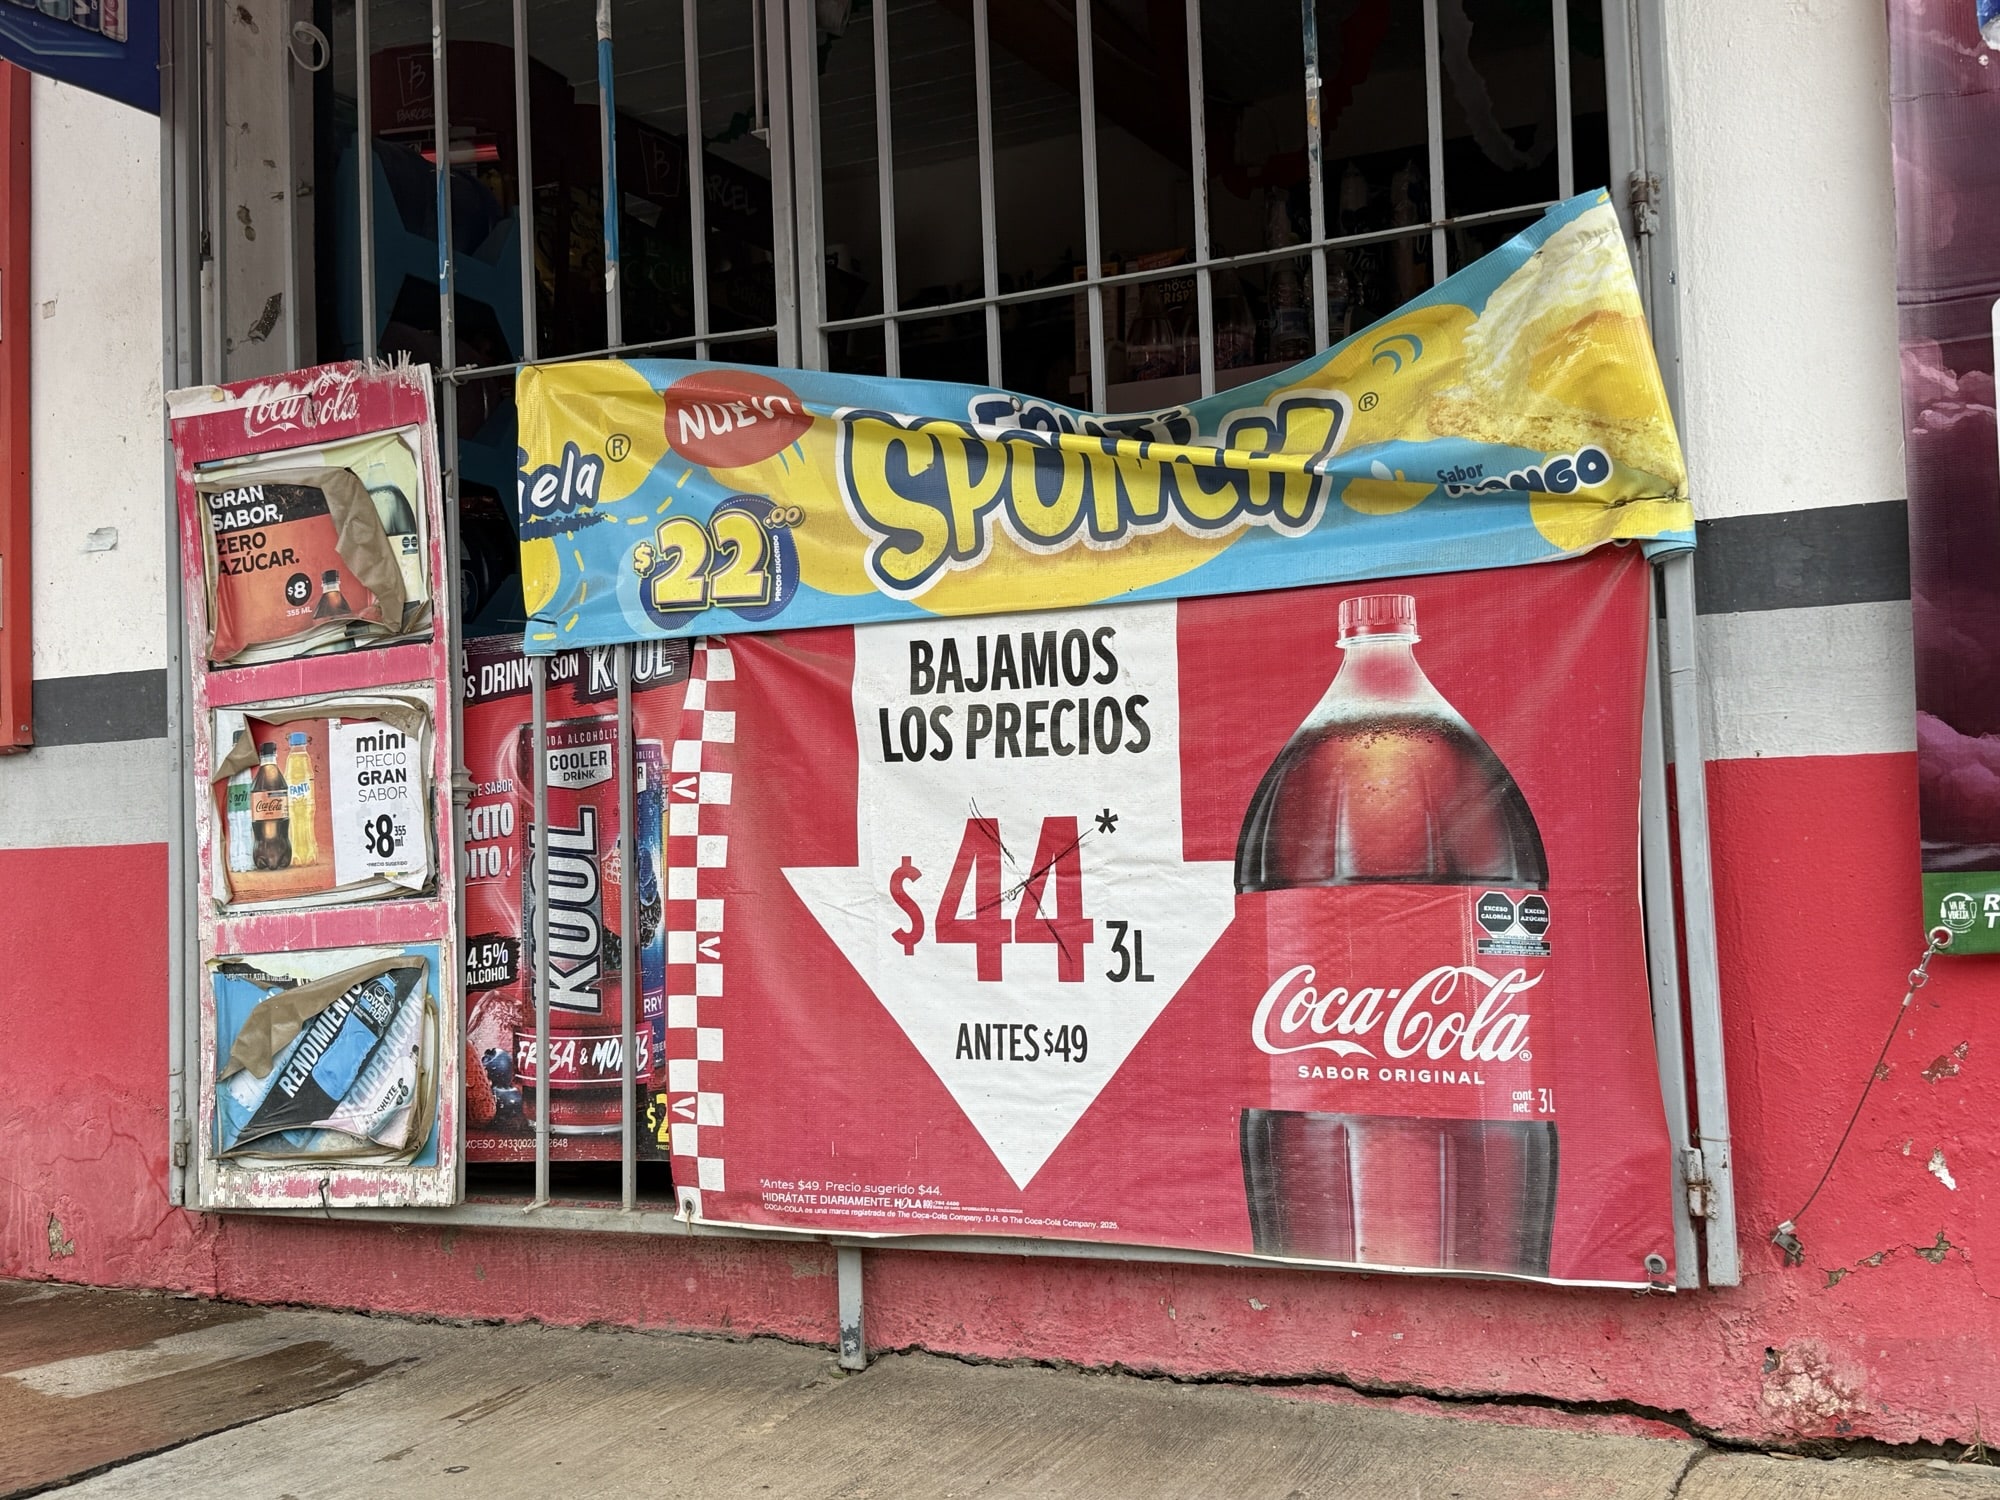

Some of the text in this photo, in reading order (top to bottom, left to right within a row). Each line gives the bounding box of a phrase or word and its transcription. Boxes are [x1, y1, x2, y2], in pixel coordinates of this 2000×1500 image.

[1437, 462, 1484, 483] Sabor
[209, 485, 265, 509] GRAN
[212, 503, 284, 532] SABOR,
[216, 532, 267, 556] ZERO
[219, 548, 300, 576] AZÚCAR.
[286, 607, 313, 617] 355 ML
[549, 653, 580, 682] SON
[909, 626, 1119, 695] BAJAMOS
[878, 694, 1152, 763] LOS PRECIOS
[356, 729, 406, 753] mini
[355, 752, 407, 769] PRECIO
[550, 750, 608, 771] COOLER
[357, 767, 407, 786] GRAN
[563, 769, 596, 781] DRINK
[358, 786, 408, 803] SABOR
[485, 778, 514, 796] SABOR
[256, 799, 283, 813] Coca-Cola
[394, 825, 407, 836] 355
[1484, 905, 1508, 913] EXCESO
[1948, 910, 1969, 919] VUELTA
[1949, 901, 1967, 910] VA DE
[466, 942, 509, 970] 4.5%
[1105, 921, 1155, 983] 3L
[466, 965, 511, 986] ALCOHOL
[1252, 964, 1546, 1062] Coca-Cola
[955, 1022, 1088, 1064] ANTES $49
[579, 1047, 589, 1066] &
[1298, 1065, 1486, 1085] SABOR ORIGINAL
[1512, 1088, 1556, 1113] cont. 3L
[1512, 1101, 1531, 1112] net.
[797, 1179, 822, 1191] $49.
[825, 1181, 862, 1192] Precio
[864, 1183, 915, 1196] sugerido
[918, 1184, 943, 1196] $44.
[762, 1192, 818, 1205] HIDRÁTATE
[820, 1195, 893, 1208] DIARIAMENTE.
[763, 1203, 804, 1214] COCA-COLA
[851, 1209, 886, 1217] registrada
[887, 1209, 896, 1217] de
[898, 1210, 910, 1218] The
[911, 1211, 949, 1220] Coca-Cola
[949, 1213, 984, 1224] Company.
[1009, 1216, 1023, 1224] The
[1024, 1216, 1061, 1226] Coca-Cola
[1062, 1219, 1099, 1230] Company.
